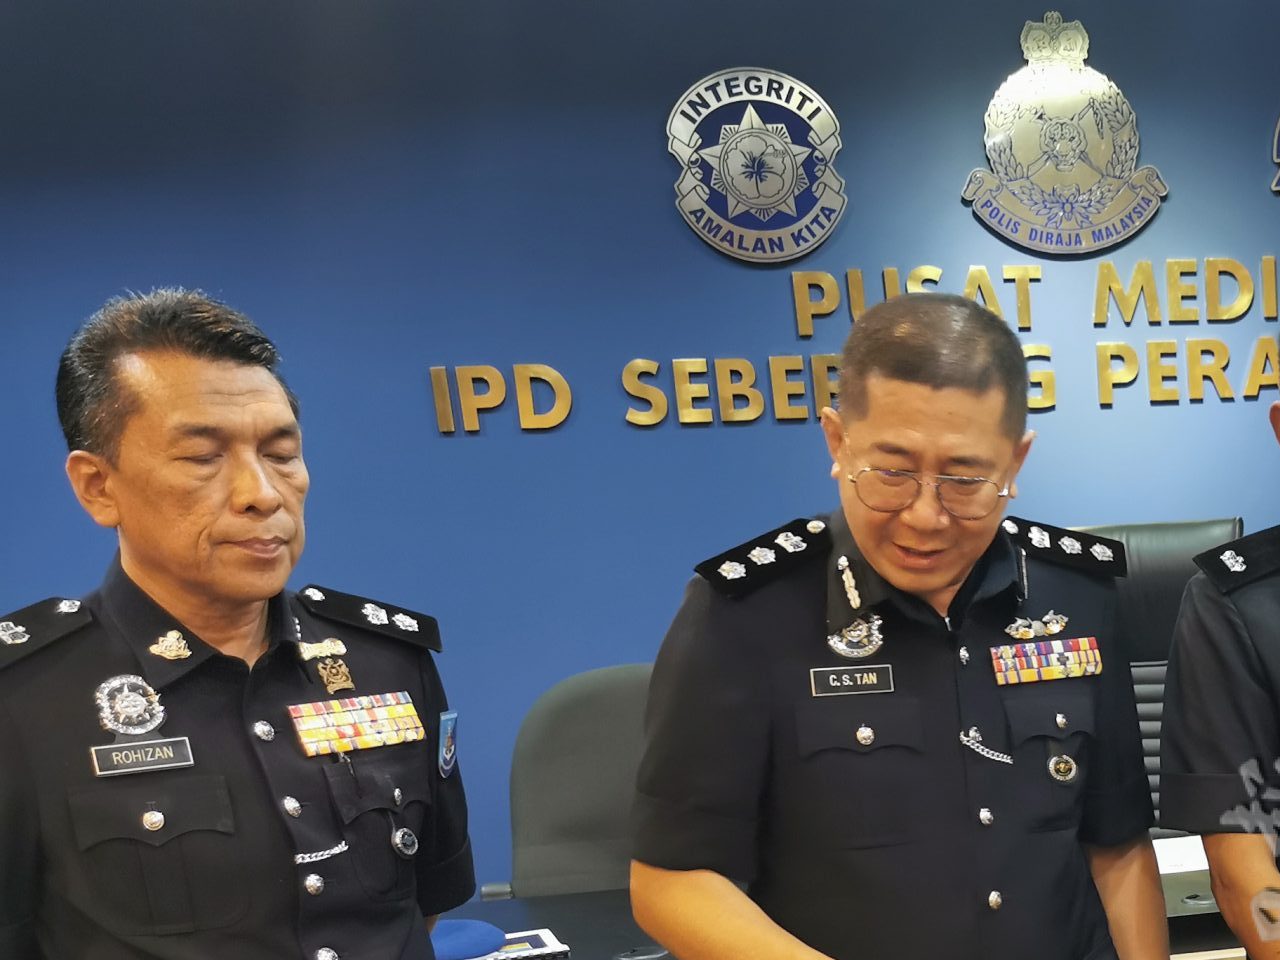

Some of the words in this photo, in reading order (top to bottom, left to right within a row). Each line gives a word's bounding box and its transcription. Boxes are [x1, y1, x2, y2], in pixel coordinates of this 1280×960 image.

[680, 76, 822, 124] INTEGRITI
[689, 207, 784, 254] AMALAN
[791, 206, 837, 248] KITA
[980, 199, 1021, 234] POLIS
[1028, 229, 1083, 246] DIRAJA
[1091, 196, 1154, 244] MALAYSIA
[430, 364, 573, 432] IPD
[112, 745, 174, 766] ROHIZAN
